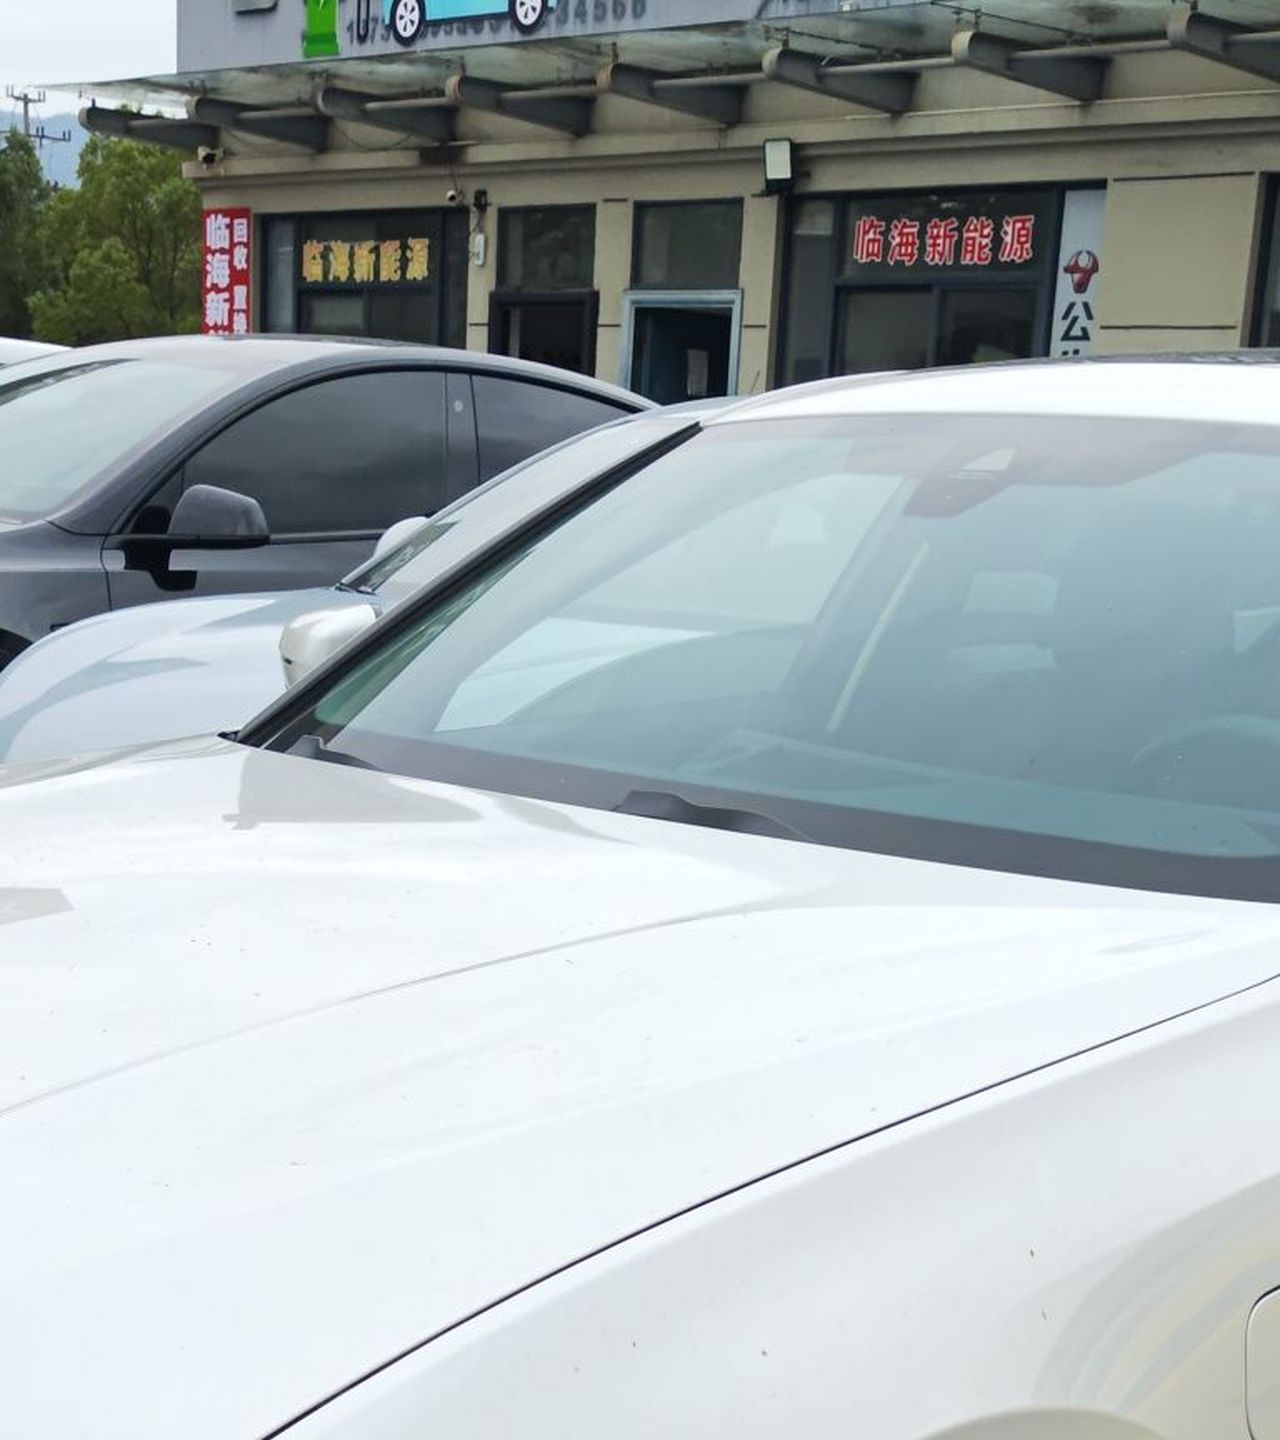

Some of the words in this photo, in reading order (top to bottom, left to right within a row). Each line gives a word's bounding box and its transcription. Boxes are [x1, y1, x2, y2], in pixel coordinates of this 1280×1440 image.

[302, 237, 429, 282] 临海新能源
[853, 215, 1035, 265] 临海新能源
[205, 214, 230, 334] 临海新
[1060, 301, 1094, 356] 公
